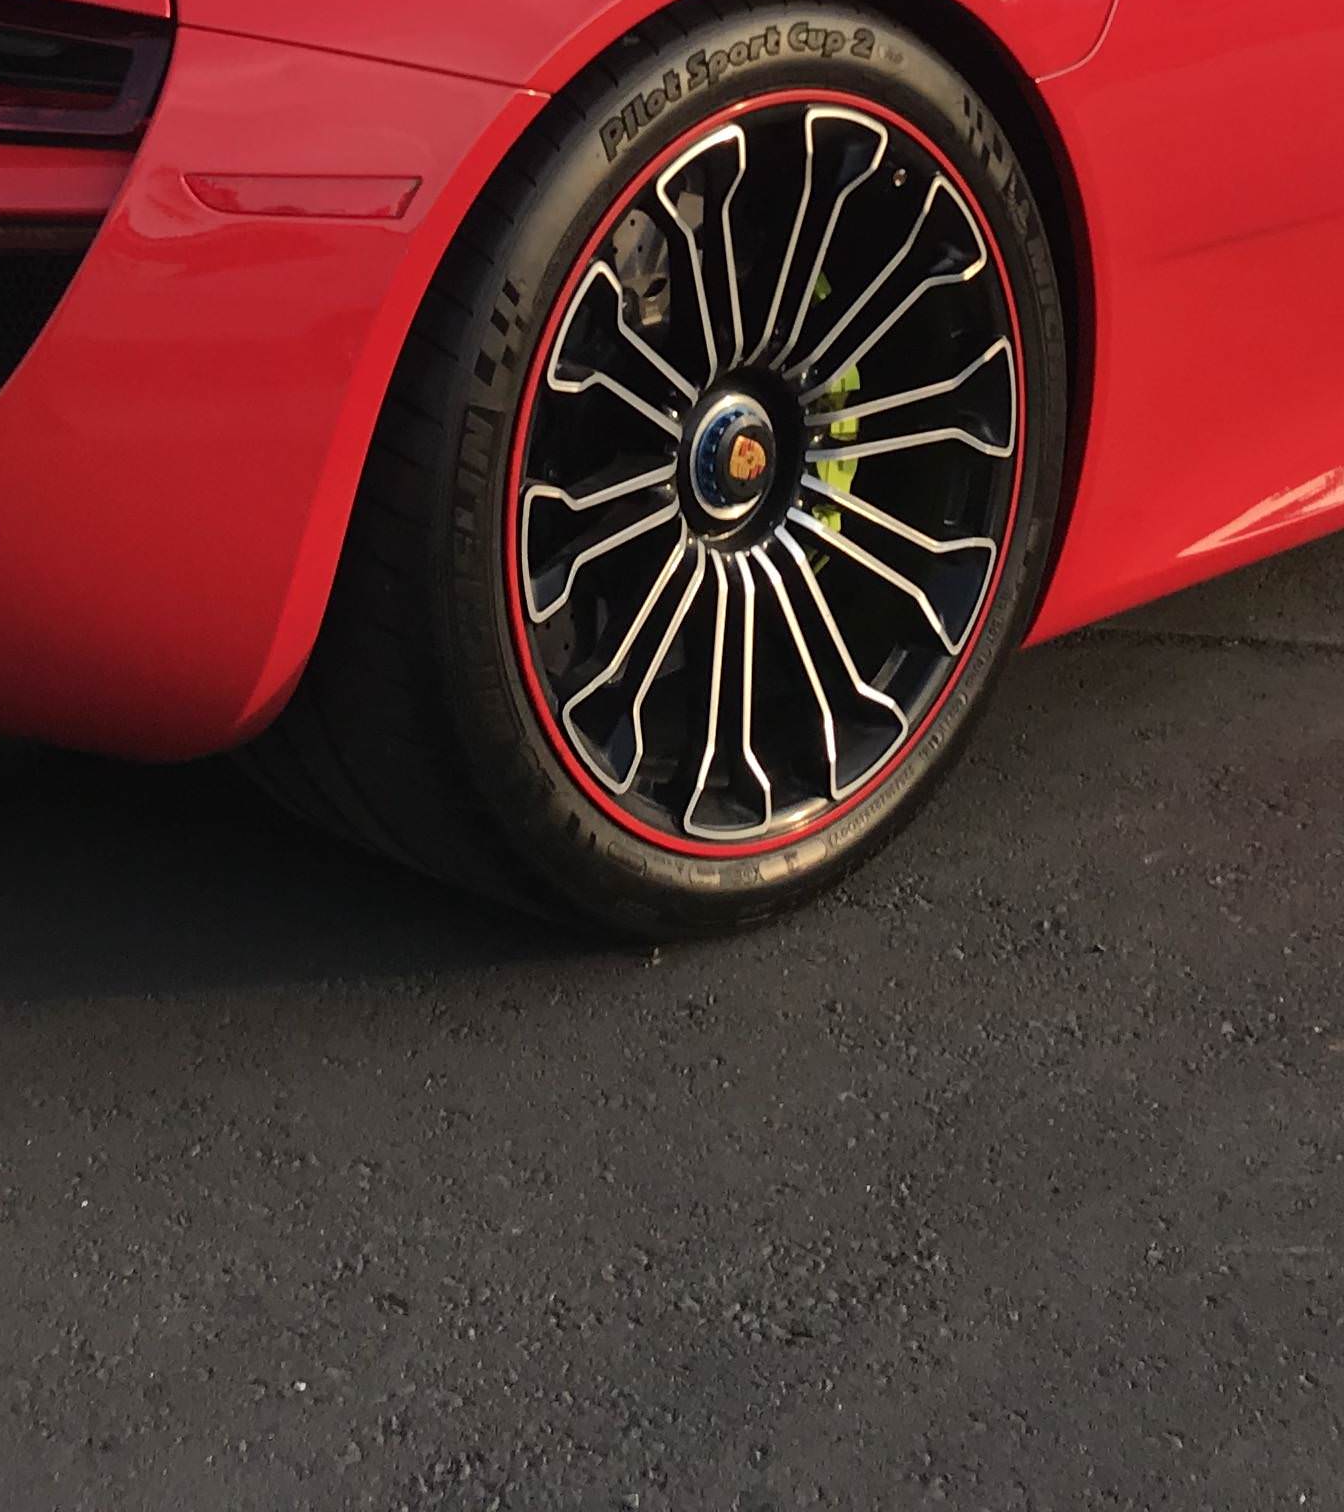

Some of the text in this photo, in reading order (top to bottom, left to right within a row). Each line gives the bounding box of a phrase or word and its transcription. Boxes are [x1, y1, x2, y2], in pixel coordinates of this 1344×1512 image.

[599, 68, 681, 163] Pilot
[686, 25, 781, 92] Sport
[787, 21, 846, 59] Cup
[851, 27, 876, 60] 2
